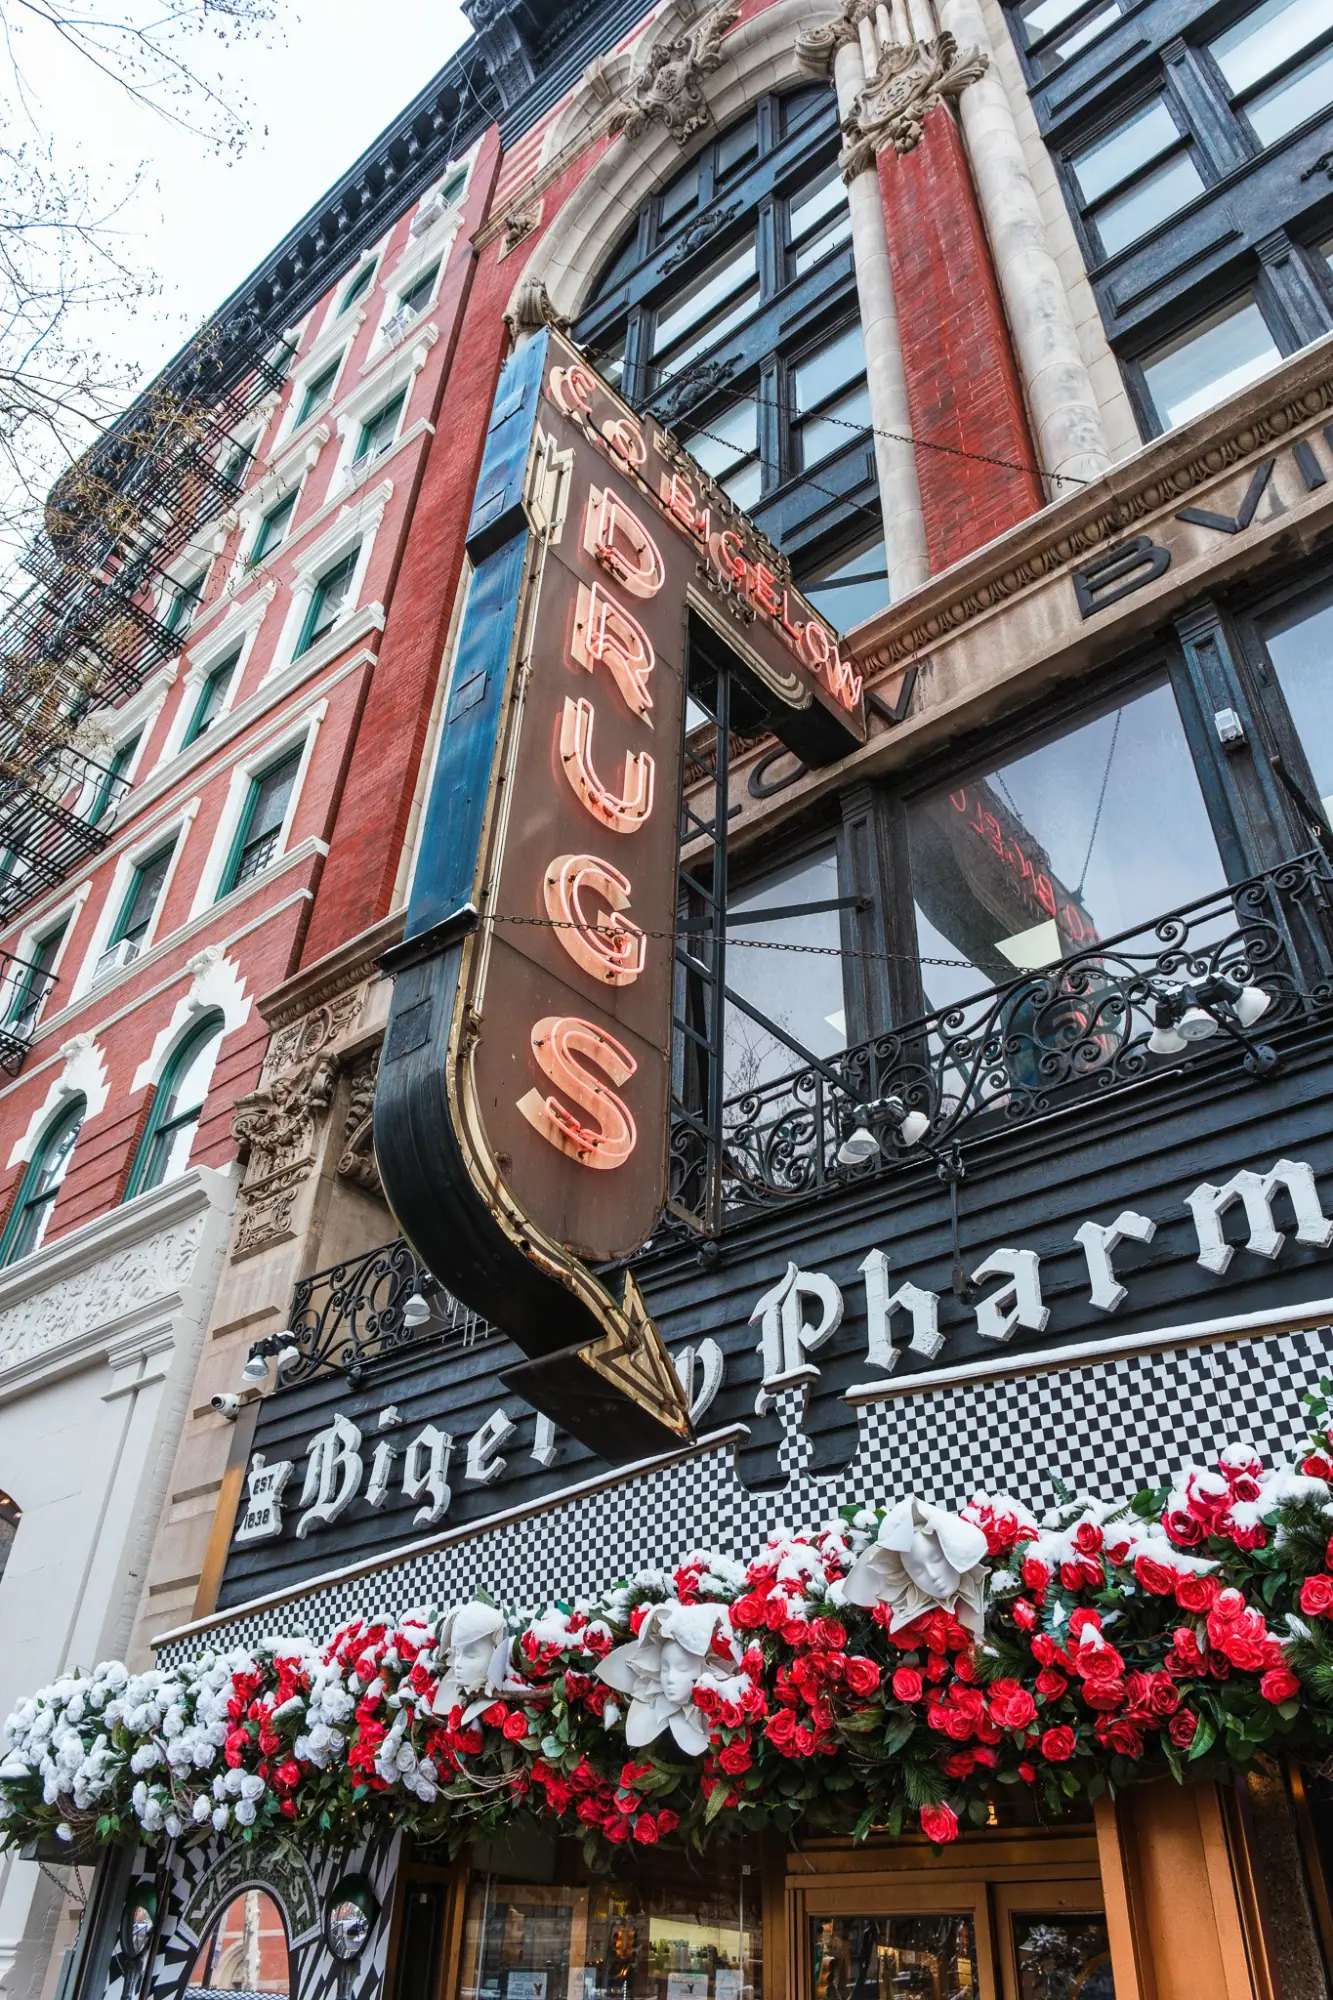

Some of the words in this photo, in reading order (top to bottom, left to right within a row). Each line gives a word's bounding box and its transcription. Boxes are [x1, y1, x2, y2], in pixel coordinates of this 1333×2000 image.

[658, 471, 863, 714] BIGELOW
[1072, 422, 1333, 620] BVI
[516, 481, 666, 1171] DRUGS
[748, 1157, 1333, 1418] Pharm
[243, 1507, 271, 1531] 1838
[252, 1473, 275, 1496] EST.
